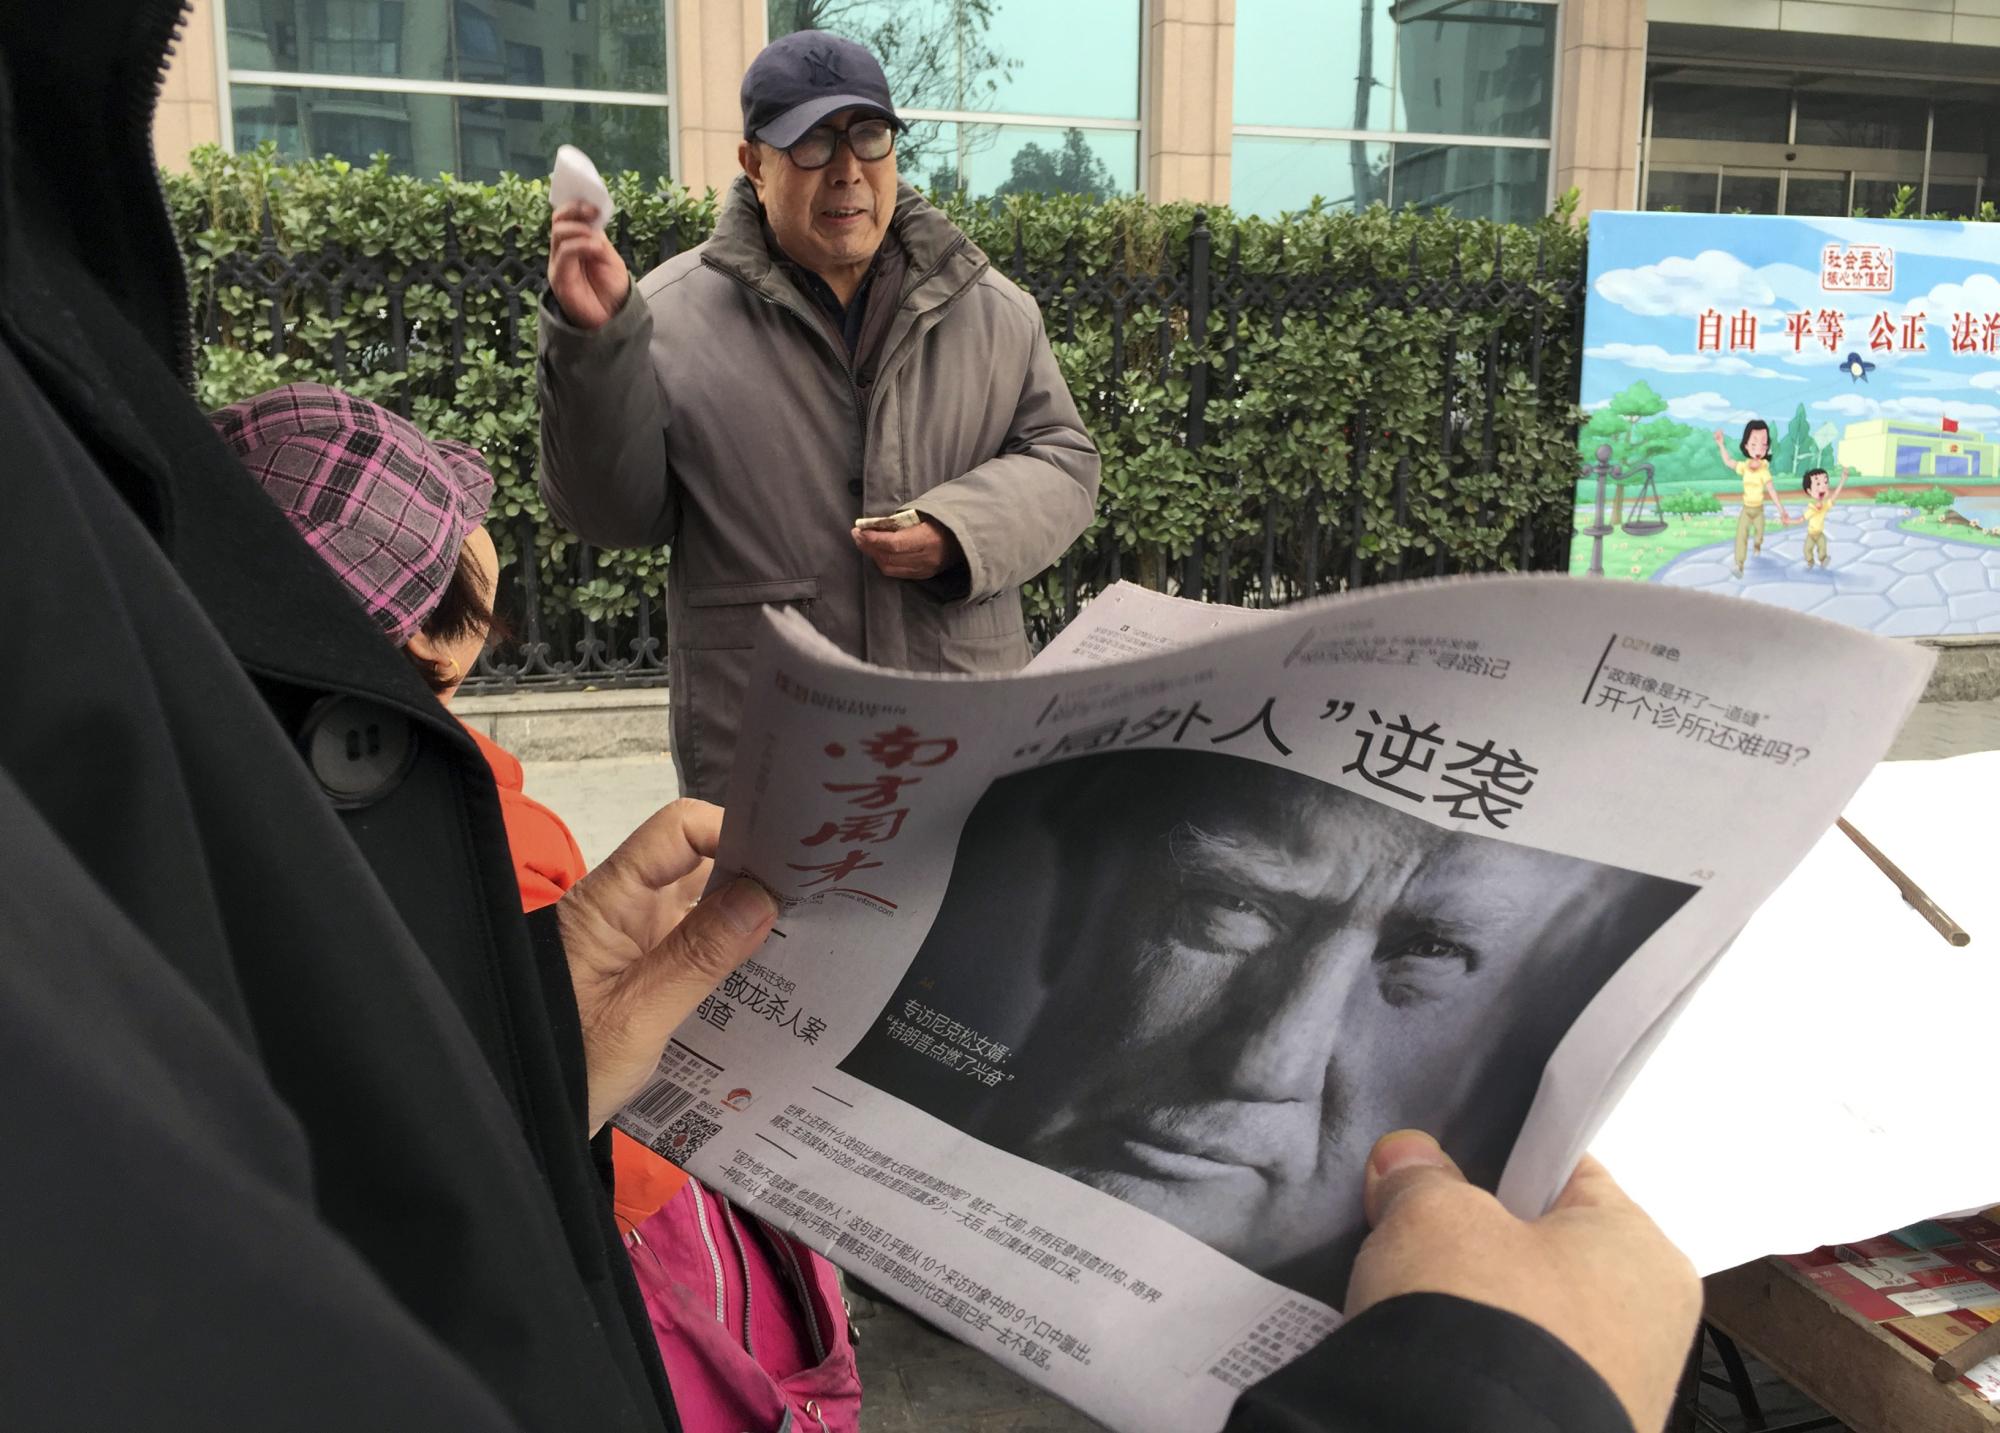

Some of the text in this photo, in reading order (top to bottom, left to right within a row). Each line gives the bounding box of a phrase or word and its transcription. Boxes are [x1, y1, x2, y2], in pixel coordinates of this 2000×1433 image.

[1828, 250, 1889, 270] 社会主义
[1698, 308, 1757, 351] 自由
[1785, 309, 1845, 351] 平等
[1868, 311, 1927, 351] 公正
